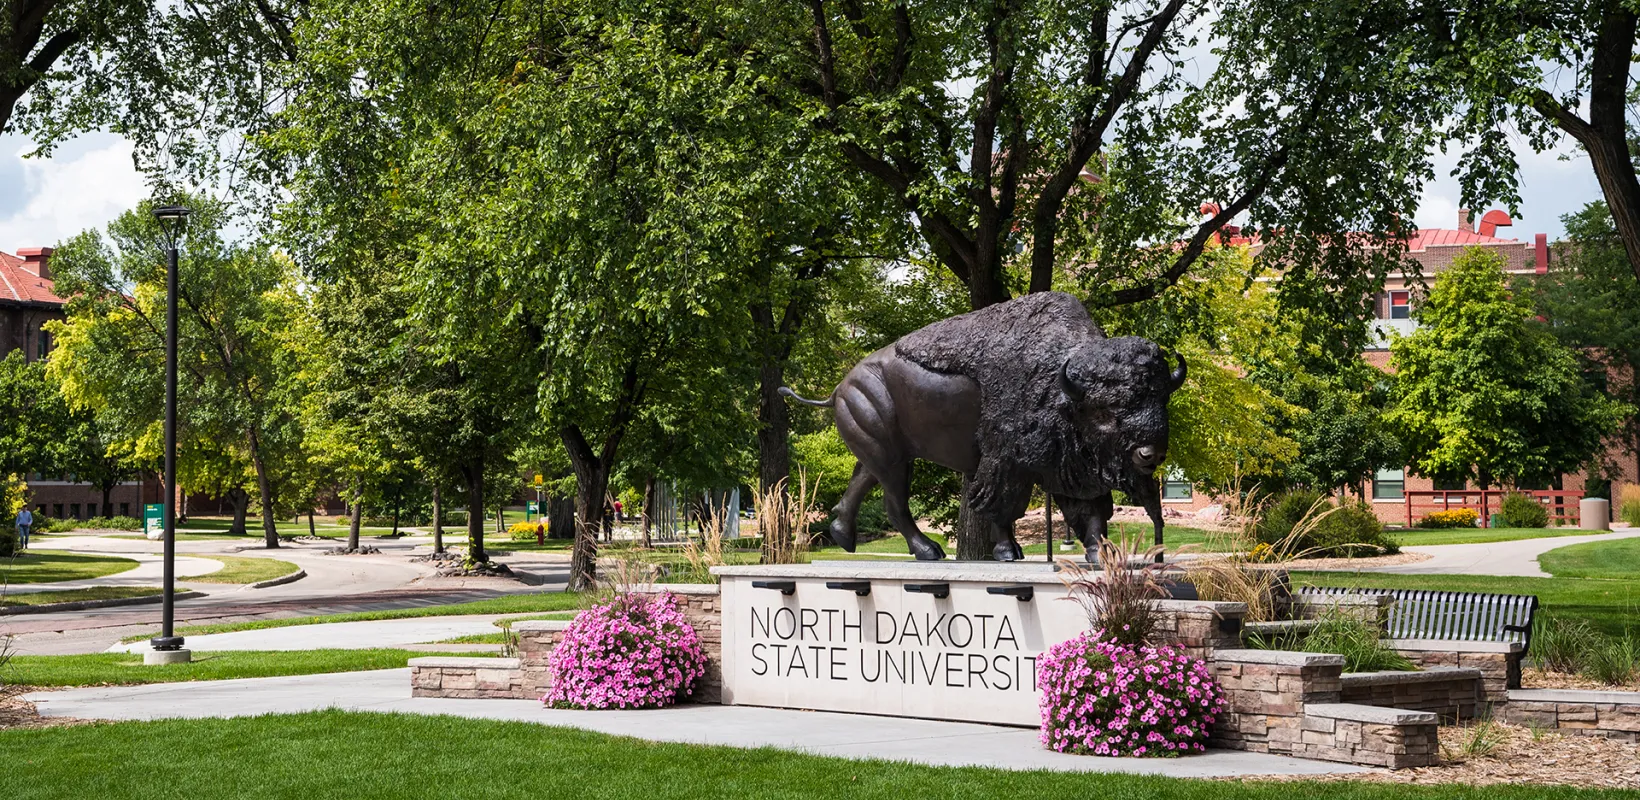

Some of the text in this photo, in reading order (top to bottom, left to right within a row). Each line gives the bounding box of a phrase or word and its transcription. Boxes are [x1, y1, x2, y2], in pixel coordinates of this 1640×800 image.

[751, 606, 1020, 651] NORTH DAKOTA
[751, 642, 1037, 692] STATE UNIVERSIT
